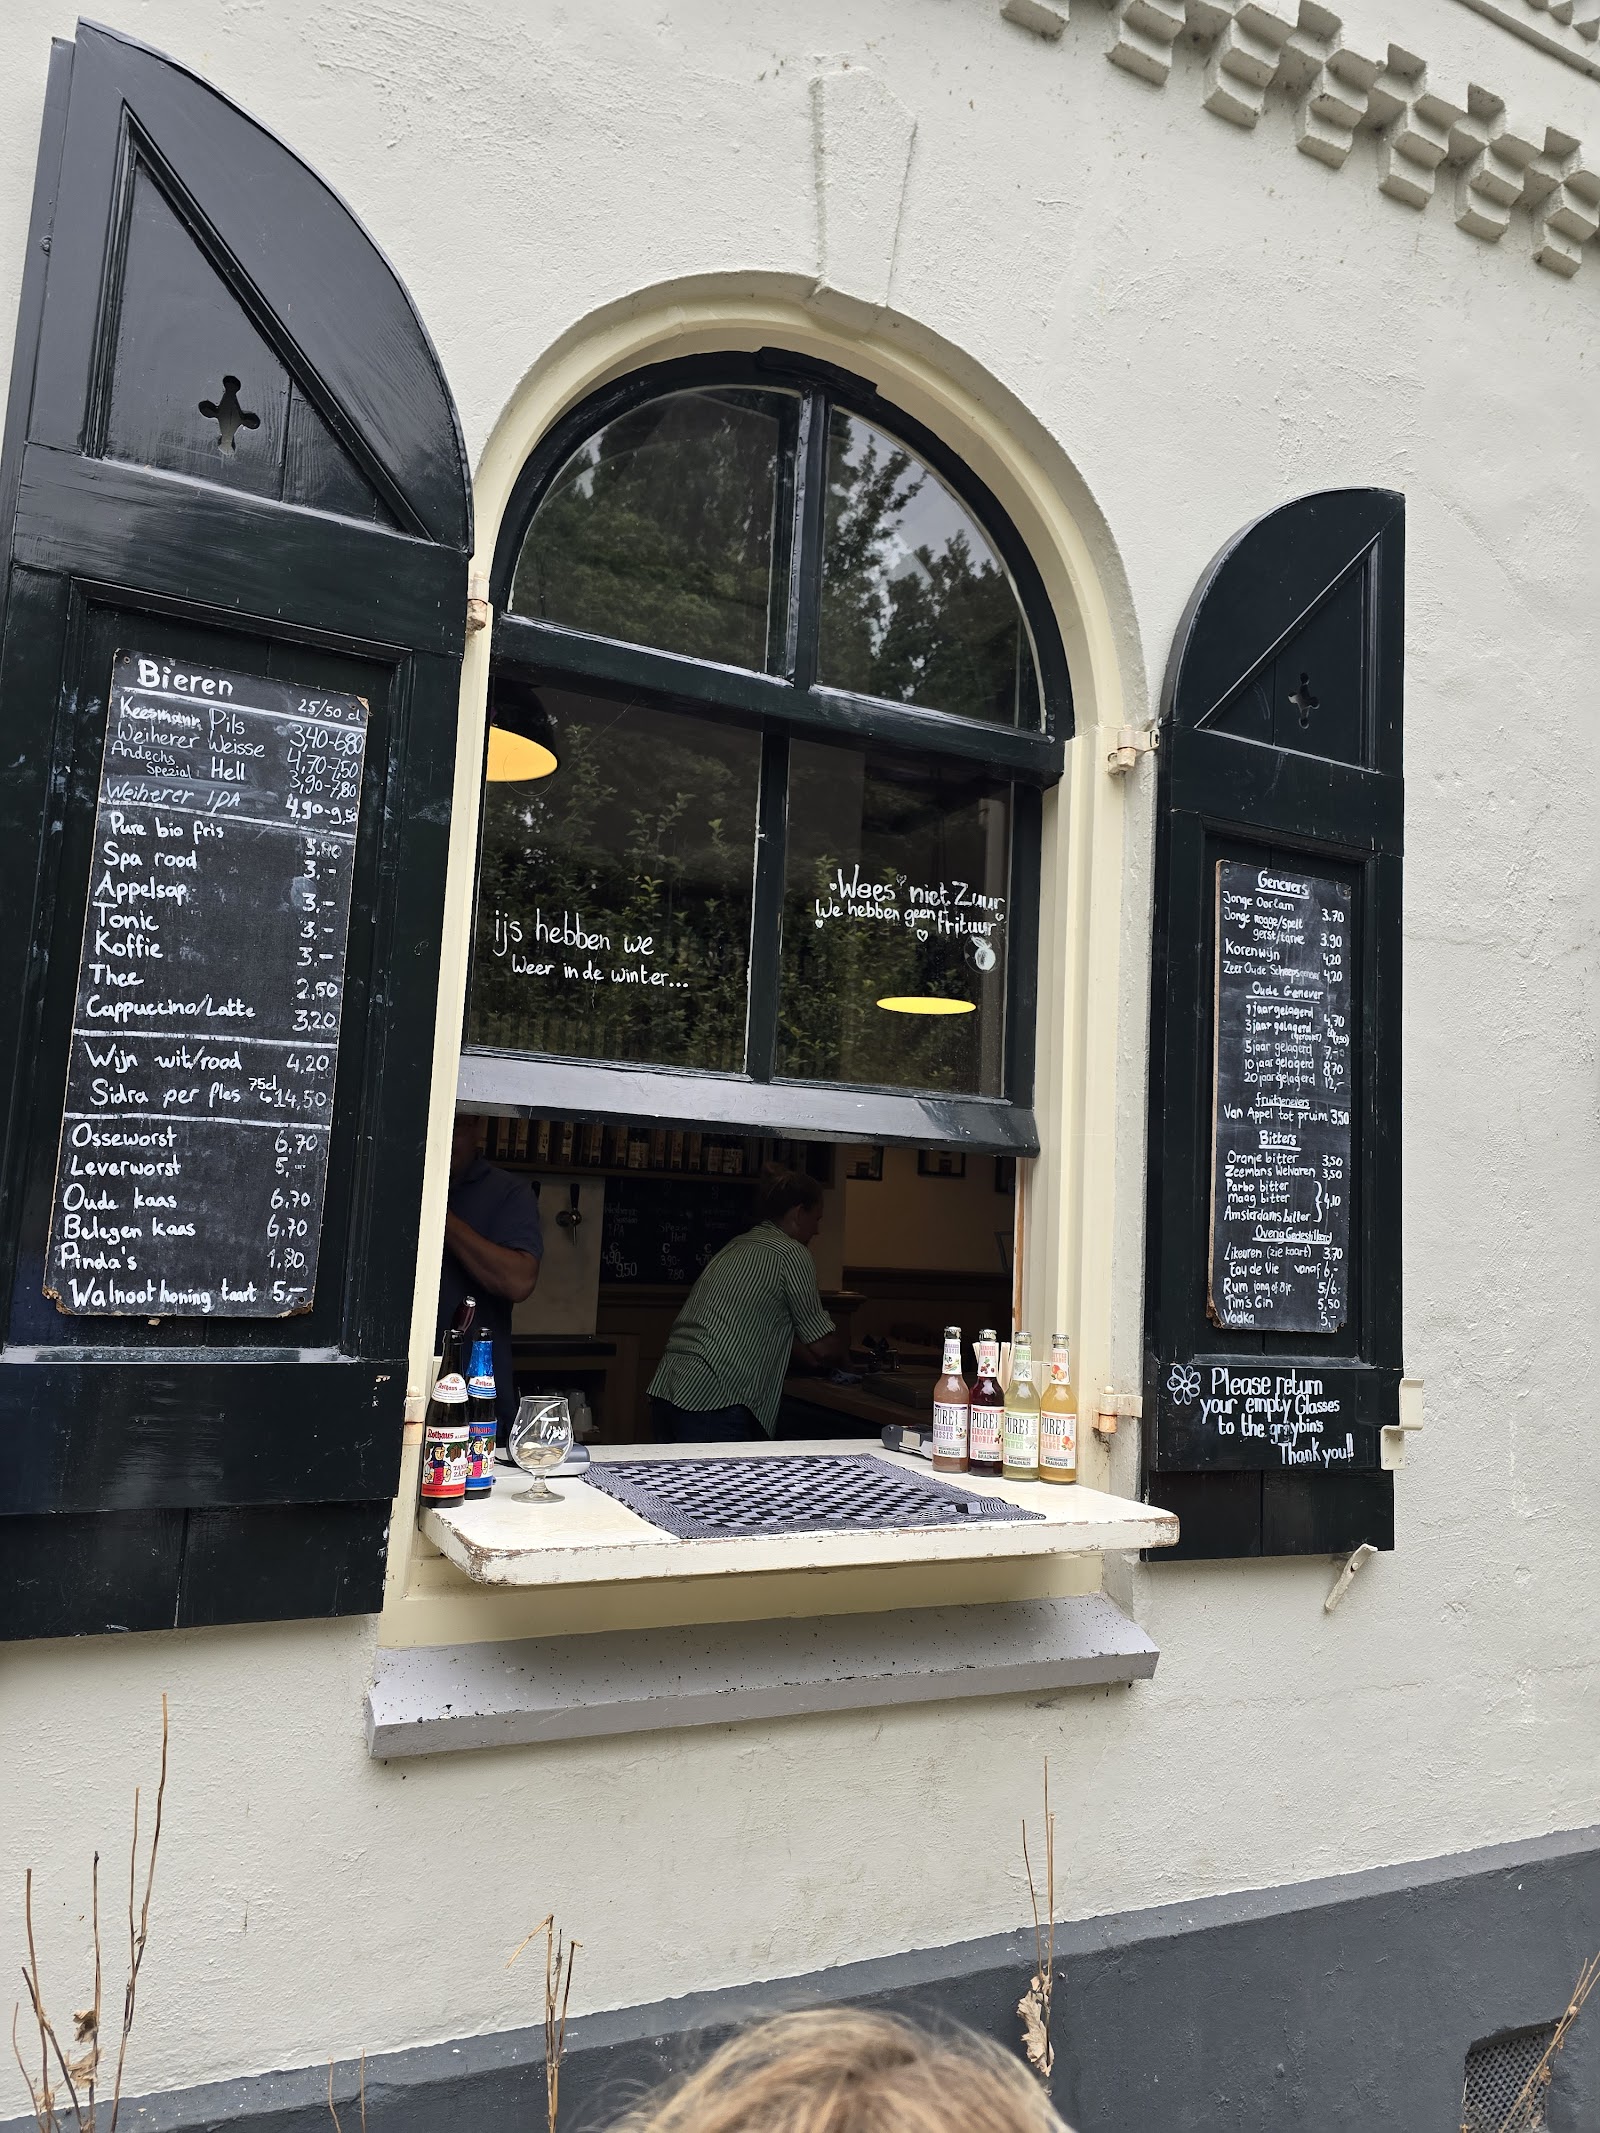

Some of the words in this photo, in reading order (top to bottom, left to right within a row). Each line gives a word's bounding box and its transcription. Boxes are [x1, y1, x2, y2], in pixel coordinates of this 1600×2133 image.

[137, 659, 234, 696] Bieren
[209, 708, 245, 734] Pils
[298, 699, 342, 718] 25/50
[117, 722, 200, 749] Weiherer
[208, 733, 266, 757] Weisse
[111, 739, 176, 765] Andechs
[210, 756, 246, 782] Hell
[146, 761, 192, 779] Spezial
[105, 779, 195, 805] Weiherer
[110, 810, 147, 837] Pure
[156, 817, 184, 838] bio
[193, 820, 225, 845] fris
[103, 840, 143, 873] Spa
[154, 850, 197, 869] rood
[94, 870, 187, 906] Appelsap
[836, 863, 897, 902] Wees
[909, 881, 951, 906] niet
[951, 880, 1006, 911] Zuur
[815, 896, 843, 918] We
[847, 899, 900, 921] hebben
[904, 908, 936, 927] geen
[1223, 891, 1253, 910] Jonge
[1256, 897, 1295, 912] Oorlam
[92, 901, 160, 932] Tonic
[1224, 907, 1250, 929] Jonge
[94, 929, 164, 959] Koffie
[492, 909, 523, 957] ijs
[535, 908, 611, 950] hebben
[623, 935, 655, 956] we
[1225, 938, 1280, 962] Korenwijn
[88, 963, 145, 988] Thee
[563, 962, 579, 979] in
[582, 960, 605, 981] de
[1223, 961, 1242, 975] Zeer
[1244, 961, 1267, 976] Oude
[1252, 981, 1279, 997] Oude
[1283, 984, 1324, 1000] Genever
[1252, 1001, 1274, 1018] jaar
[1252, 1019, 1272, 1034] jaar
[84, 1042, 138, 1073] Wijn
[1244, 1040, 1252, 1054] 5
[1252, 1041, 1271, 1055] jaar
[1244, 1059, 1255, 1070] 10
[1256, 1059, 1274, 1072] jaar
[1244, 1073, 1258, 1083] 20
[1258, 1072, 1274, 1087] jaar
[89, 1078, 149, 1106] Sidra
[163, 1087, 199, 1108] per
[208, 1083, 241, 1108] fles
[1223, 1103, 1243, 1119] Van
[1247, 1107, 1273, 1124] Appel
[1278, 1109, 1294, 1122] tot
[1298, 1111, 1329, 1129] pruim
[71, 1122, 177, 1150] Osseworst
[1258, 1130, 1297, 1145] Bitters
[70, 1154, 181, 1177] Leverworst
[1227, 1150, 1262, 1169] Oranje
[1265, 1152, 1300, 1164] bitter
[63, 1183, 119, 1212] Oude
[134, 1188, 178, 1209] kaas
[1259, 1180, 1290, 1194] bitter
[1260, 1192, 1291, 1203] bitter
[1224, 1206, 1282, 1222] Amsterdams
[1283, 1209, 1312, 1223] bitter
[64, 1213, 142, 1245] Belegen
[152, 1218, 196, 1238] kaas
[1255, 1225, 1285, 1244] Overig
[60, 1241, 138, 1271] Pinda's
[1224, 1242, 1263, 1260] Likeuren
[1250, 1263, 1262, 1275] de
[1265, 1262, 1280, 1275] Vie
[1294, 1264, 1322, 1279] vanaf
[159, 1282, 211, 1312] honing
[221, 1275, 257, 1302] taart
[1223, 1278, 1248, 1294] Rum
[1255, 1297, 1274, 1309] Gin
[1223, 1309, 1255, 1324] Vodka
[1211, 1367, 1271, 1396] Please
[1275, 1368, 1323, 1396] return
[1200, 1397, 1238, 1424] your
[1245, 1393, 1292, 1424] empty
[1295, 1394, 1340, 1416] Glasses
[1218, 1414, 1235, 1435] to
[1241, 1413, 1265, 1438] the
[1277, 1437, 1321, 1466] Thank
